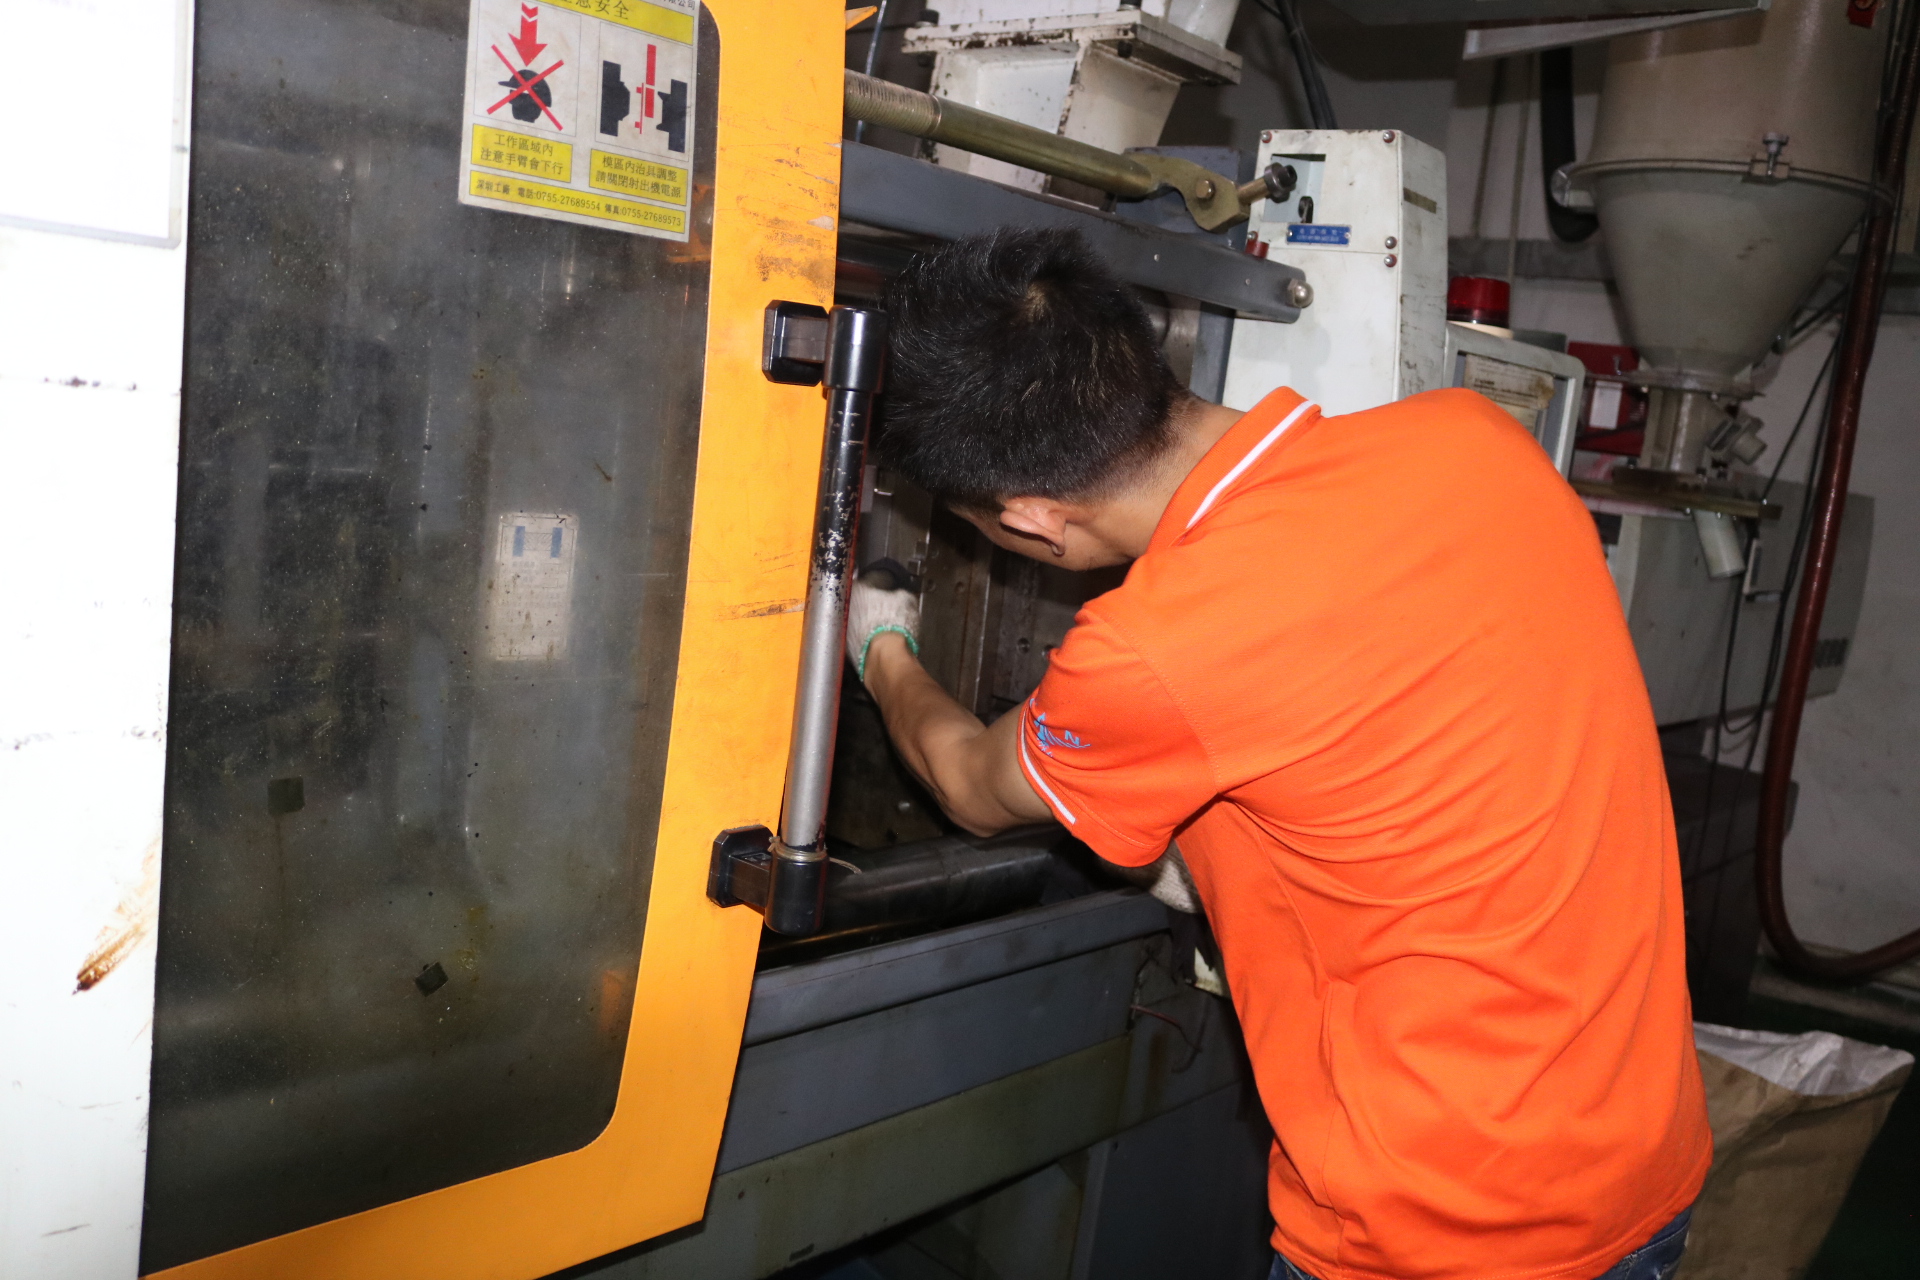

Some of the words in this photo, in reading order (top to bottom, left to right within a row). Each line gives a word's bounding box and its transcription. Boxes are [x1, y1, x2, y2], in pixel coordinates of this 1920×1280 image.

[563, 0, 629, 20] 安全
[494, 133, 553, 157] 工作區域內
[481, 147, 563, 175] 注意手臂會下行
[602, 155, 677, 182] 模區內治具調整
[596, 170, 681, 198] 請關閉射出機電源
